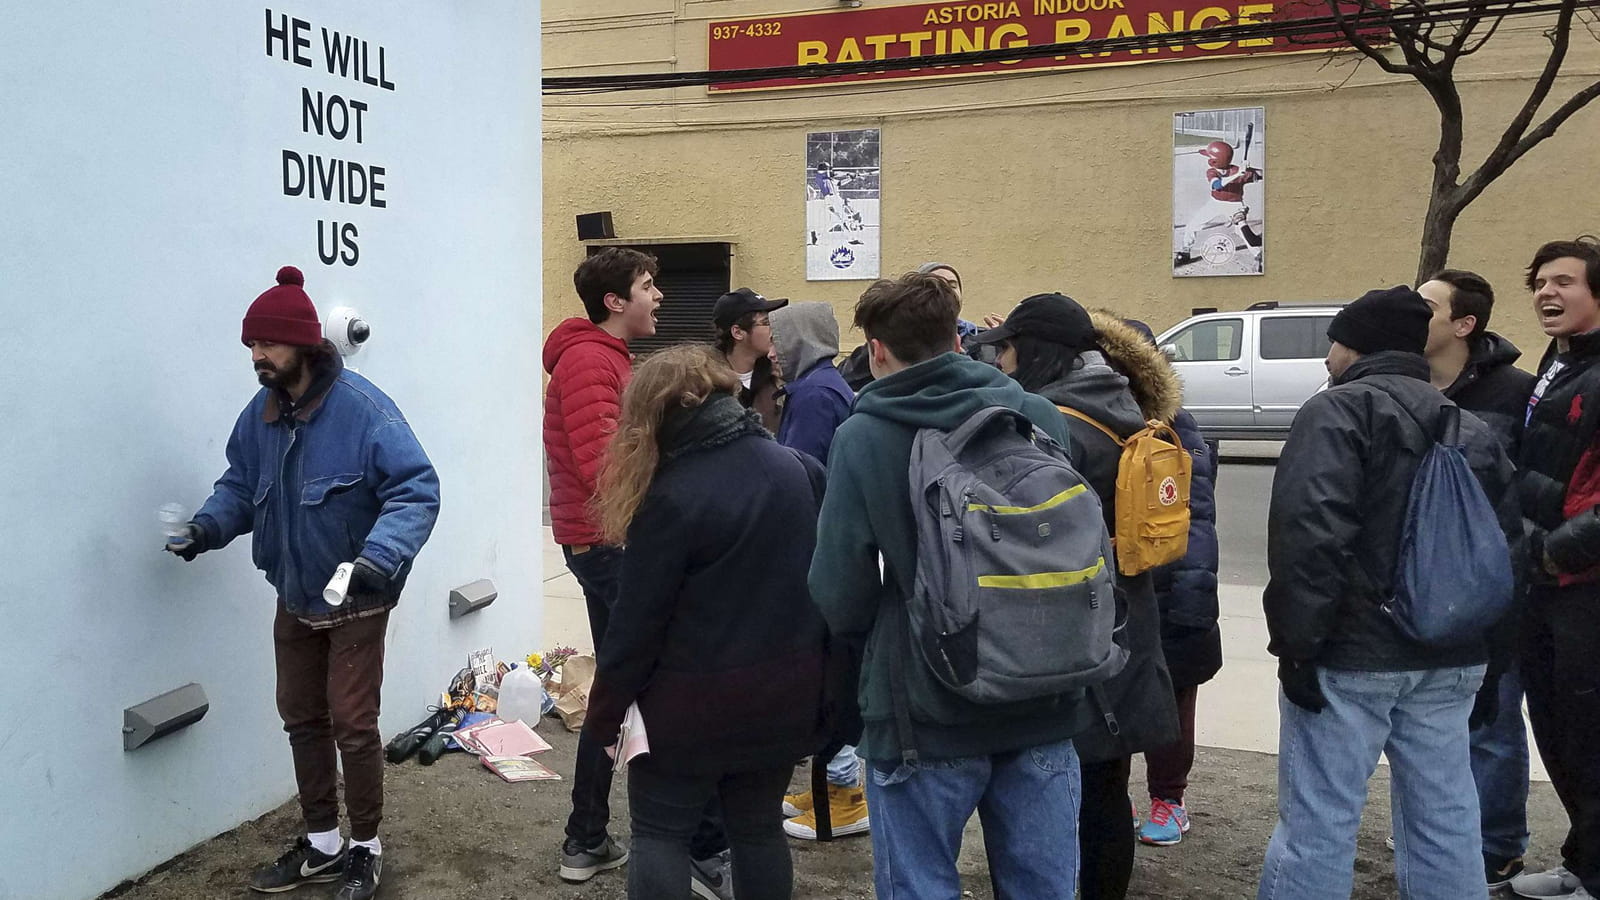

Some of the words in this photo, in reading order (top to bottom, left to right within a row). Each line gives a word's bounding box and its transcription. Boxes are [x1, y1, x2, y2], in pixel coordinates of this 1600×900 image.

[713, 22, 782, 40] 937-4332
[797, 23, 1028, 79] BATTING
[1054, 4, 1274, 61] RANGE
[923, 2, 1021, 25] ASTORIA
[265, 8, 312, 68] HE
[321, 27, 395, 91] WILL
[302, 87, 368, 144] NOT
[282, 149, 387, 208] DIVIDE
[317, 220, 360, 266] US
